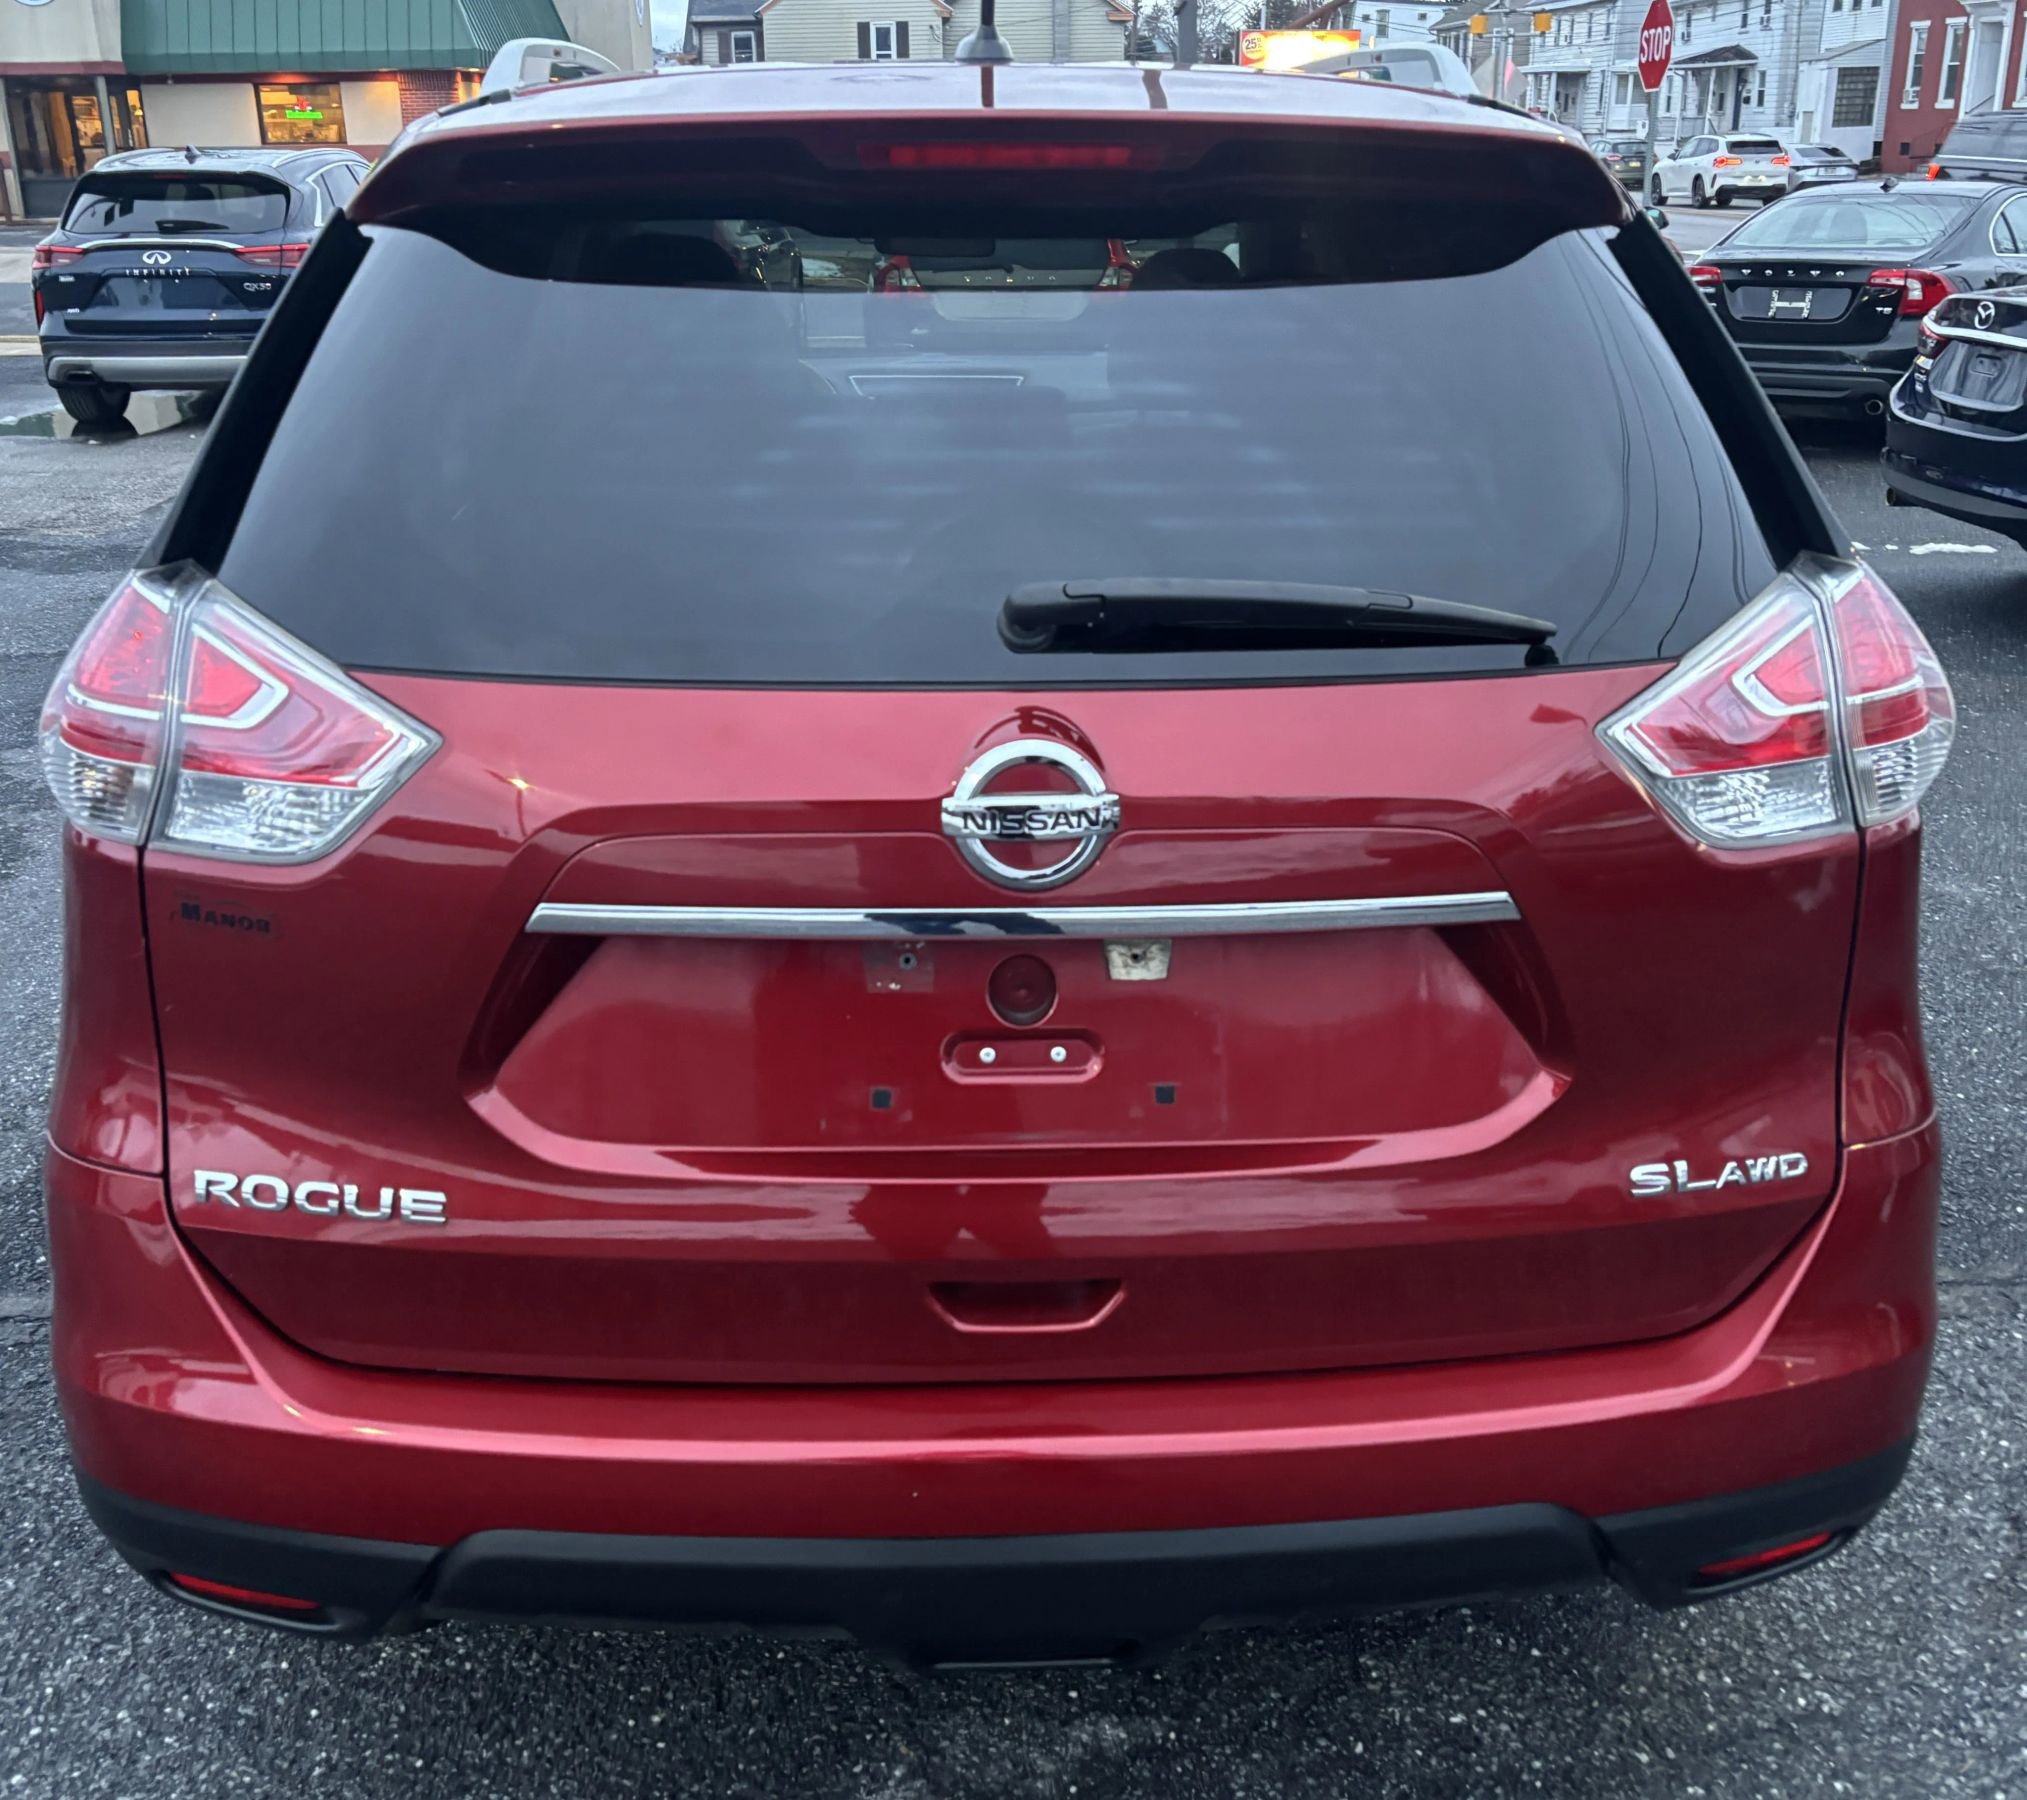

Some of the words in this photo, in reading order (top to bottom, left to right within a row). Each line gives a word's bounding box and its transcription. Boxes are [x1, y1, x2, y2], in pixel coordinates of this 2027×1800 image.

[1245, 39, 1257, 49] 25
[1640, 25, 1671, 64] STOP
[1741, 269, 1845, 277] VOLVO
[961, 809, 1101, 832] NISSAN
[194, 1169, 447, 1223] ROGUE
